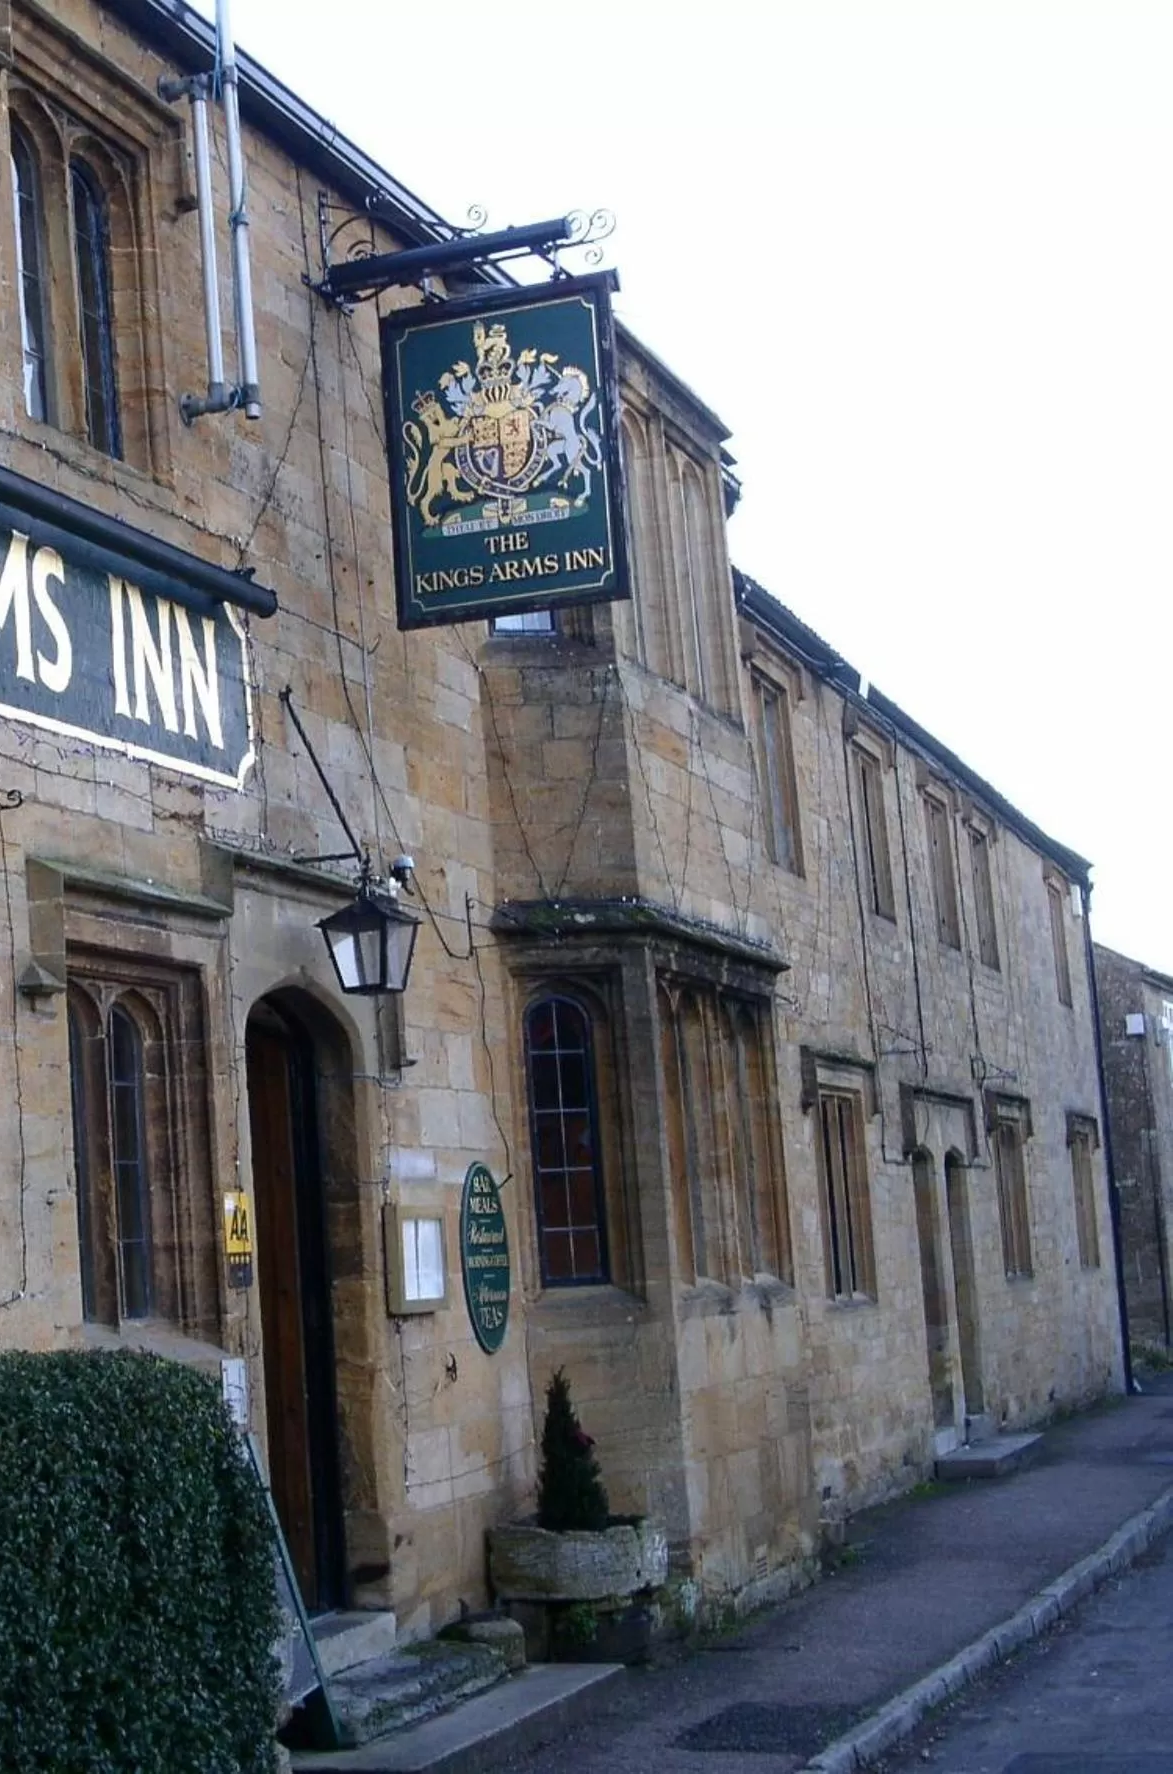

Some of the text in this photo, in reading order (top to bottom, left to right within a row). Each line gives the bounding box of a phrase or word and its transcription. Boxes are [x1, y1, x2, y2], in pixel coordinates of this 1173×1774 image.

[484, 532, 529, 554] THE
[416, 547, 604, 593] KINGS ARMS INN
[108, 573, 224, 750] INN
[473, 1174, 492, 1192] BAR
[469, 1196, 499, 1214] MEALS
[230, 1205, 249, 1242] AA
[479, 1306, 503, 1329] TEAS
